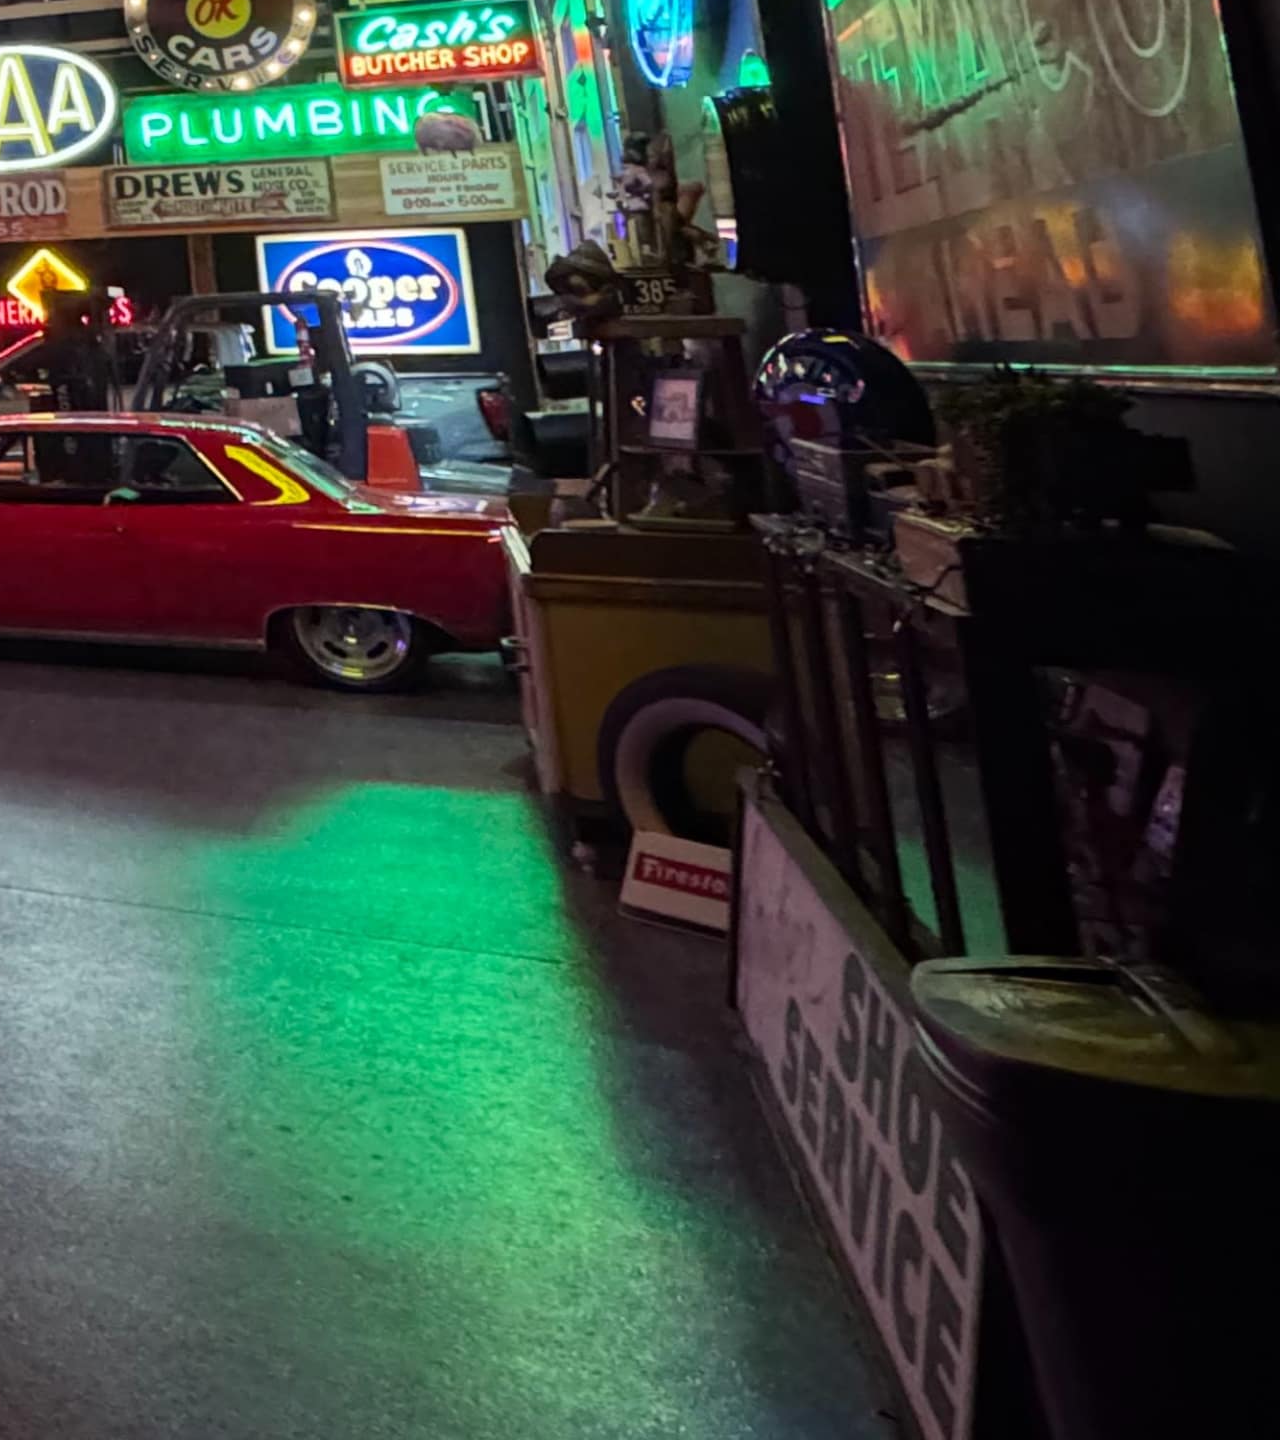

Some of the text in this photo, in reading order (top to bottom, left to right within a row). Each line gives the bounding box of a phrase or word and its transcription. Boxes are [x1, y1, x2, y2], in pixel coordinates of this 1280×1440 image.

[166, 25, 278, 72] CARS
[356, 7, 516, 54] Cash's
[349, 41, 529, 77] BUTCHER SHOP
[461, 156, 507, 170] PARTS
[640, 857, 730, 896] Firesto
